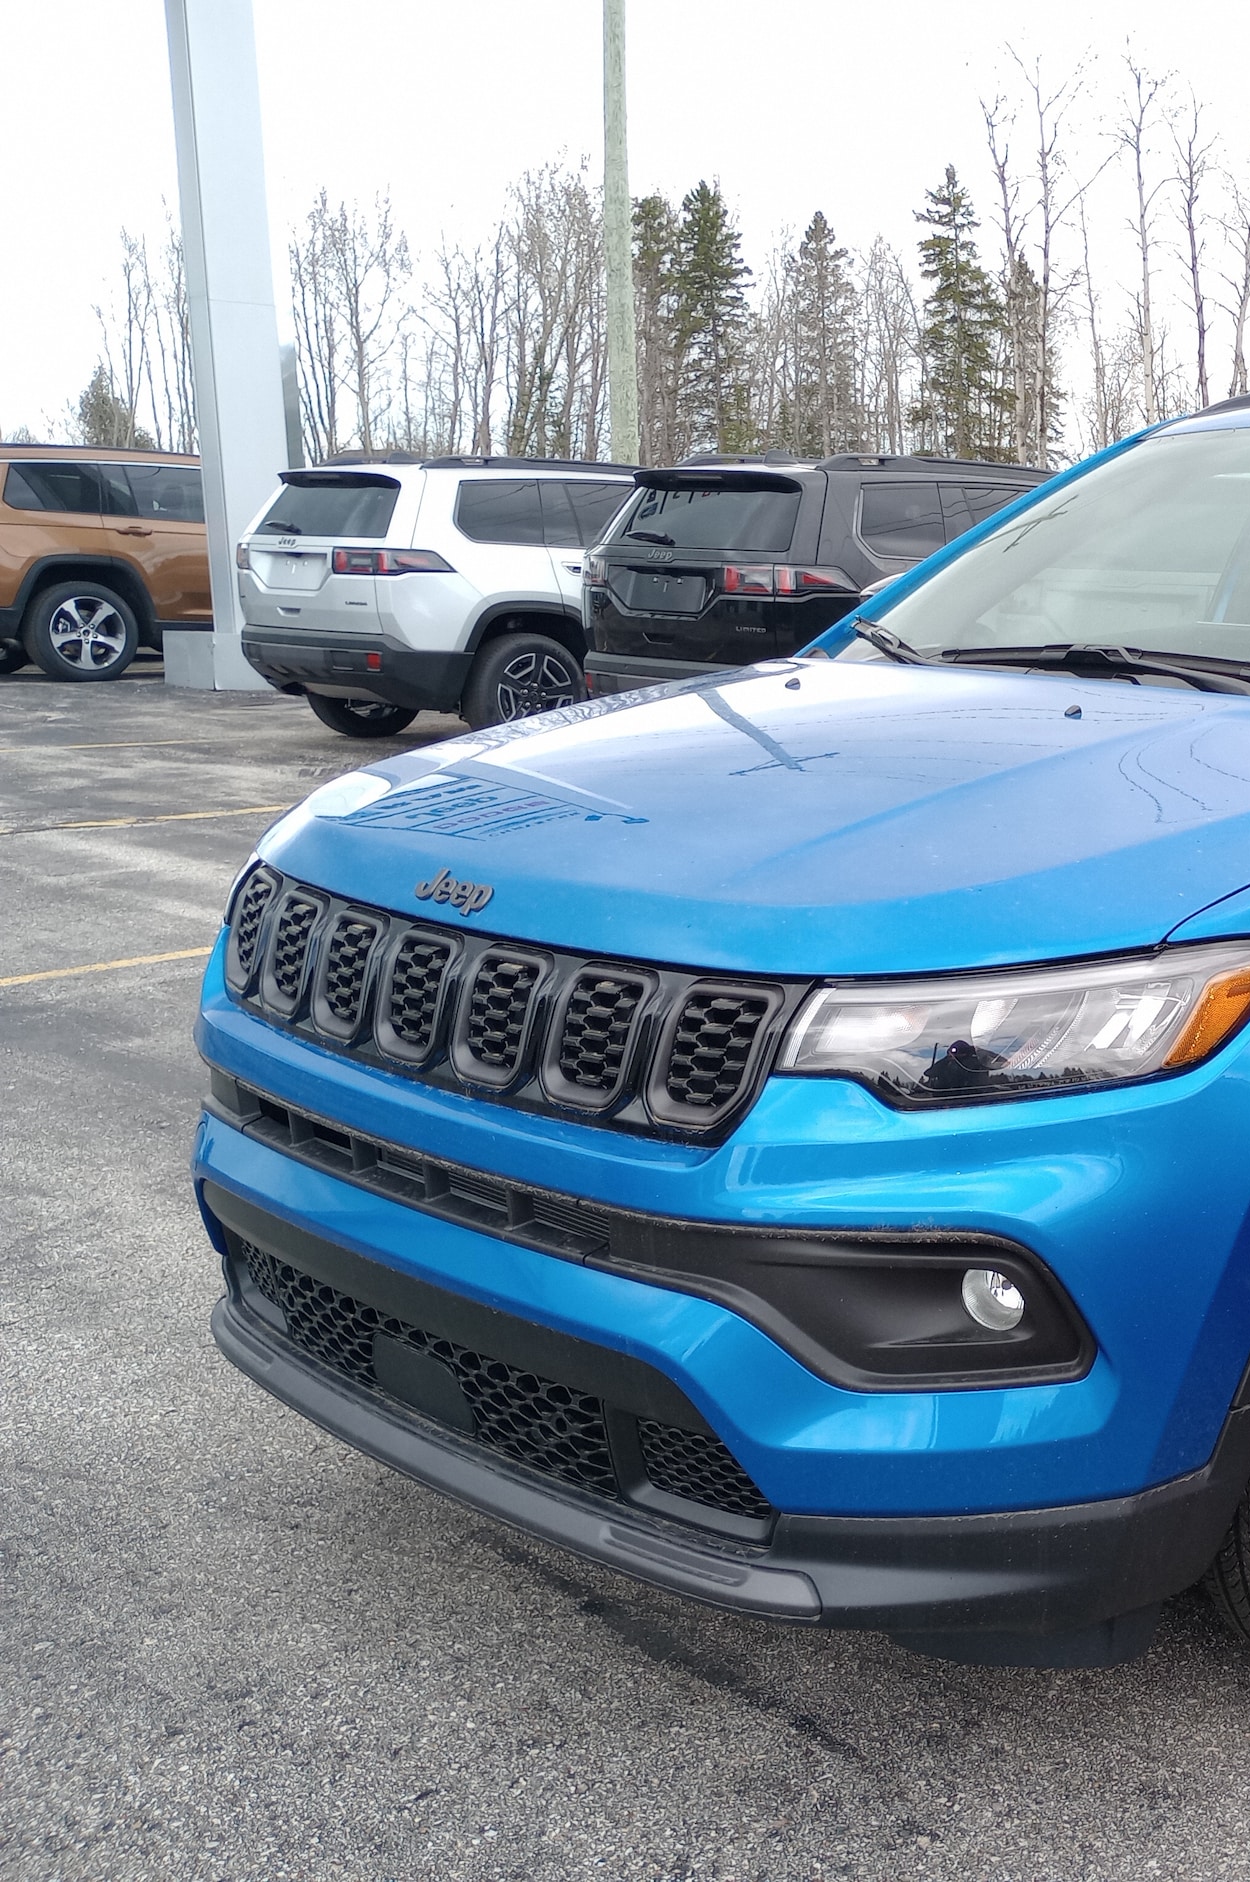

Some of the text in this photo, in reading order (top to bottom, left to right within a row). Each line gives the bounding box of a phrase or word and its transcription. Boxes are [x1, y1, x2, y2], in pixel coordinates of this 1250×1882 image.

[278, 537, 297, 546] Jeep
[648, 549, 673, 560] Jeep
[415, 867, 494, 917] Jeep
